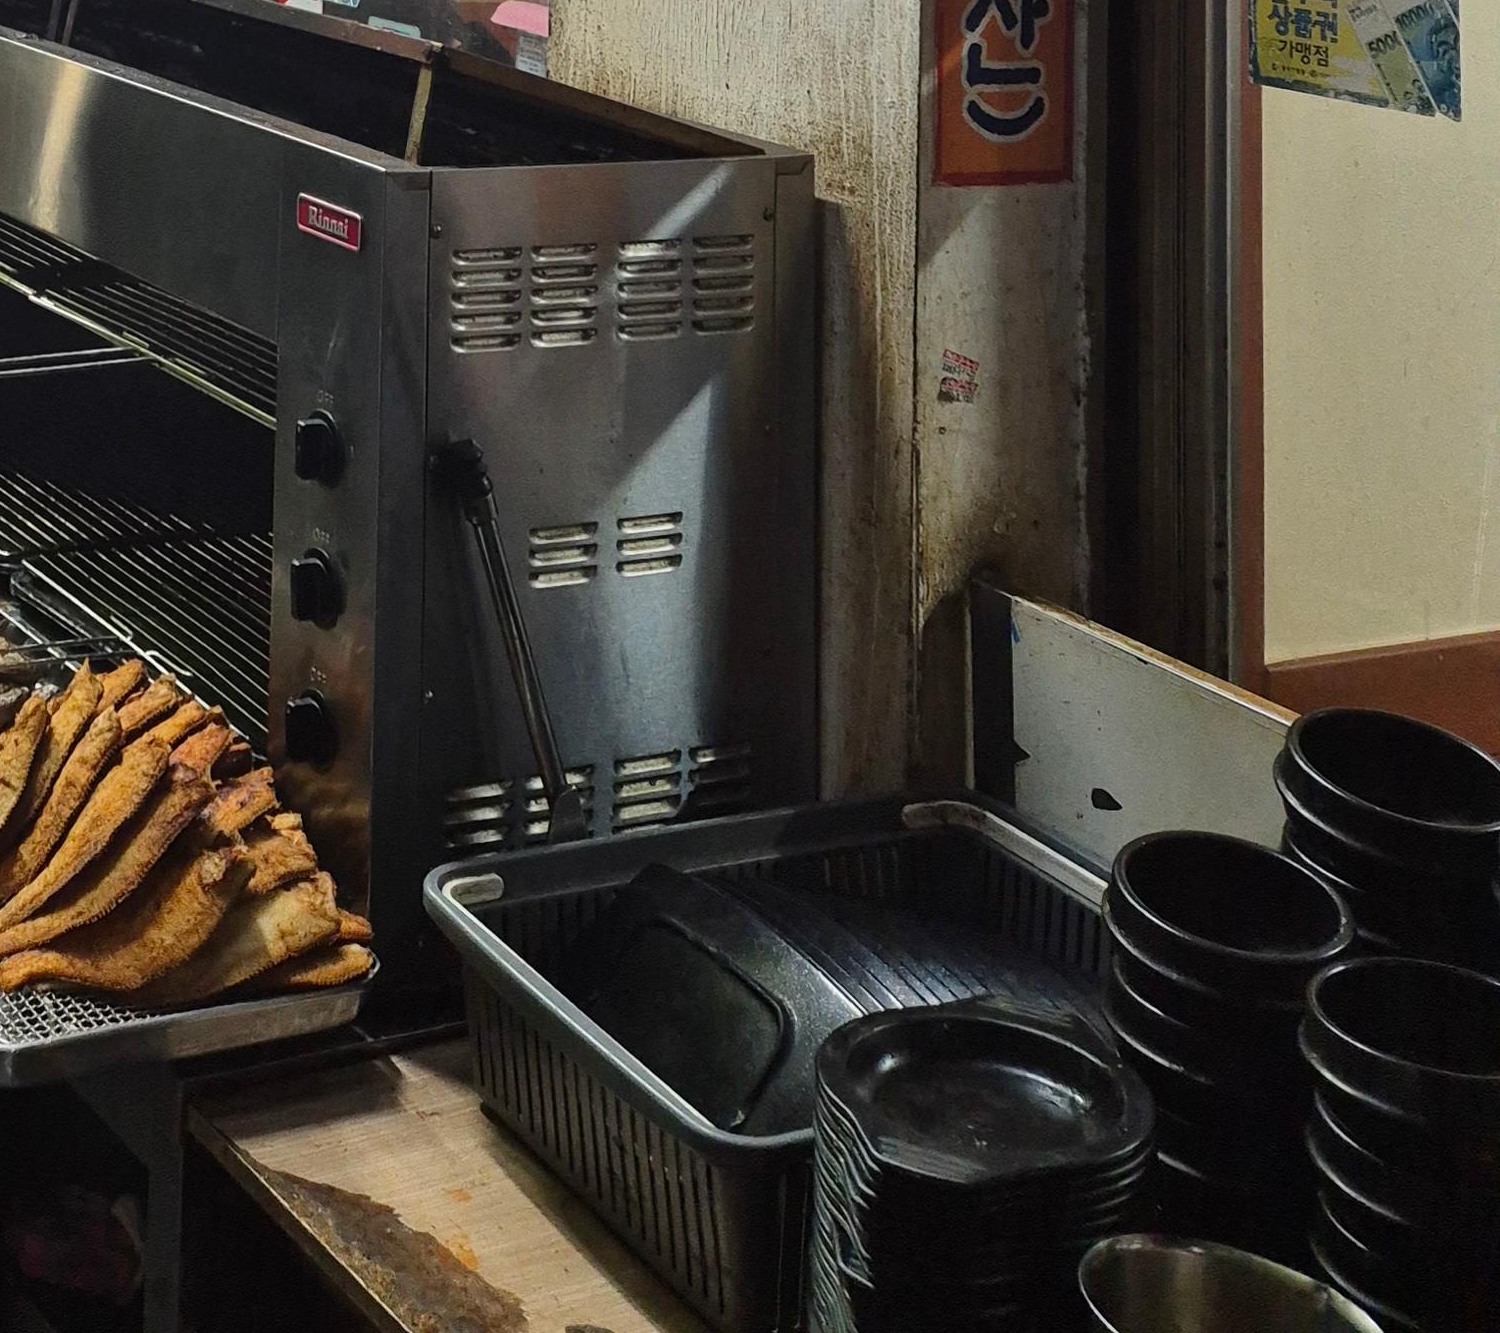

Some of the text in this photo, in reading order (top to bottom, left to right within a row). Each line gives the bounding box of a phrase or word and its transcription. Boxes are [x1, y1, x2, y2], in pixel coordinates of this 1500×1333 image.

[1267, 3, 1339, 44] 상품권
[1277, 39, 1330, 67] 가맹점
[308, 205, 349, 239] Rinnai
